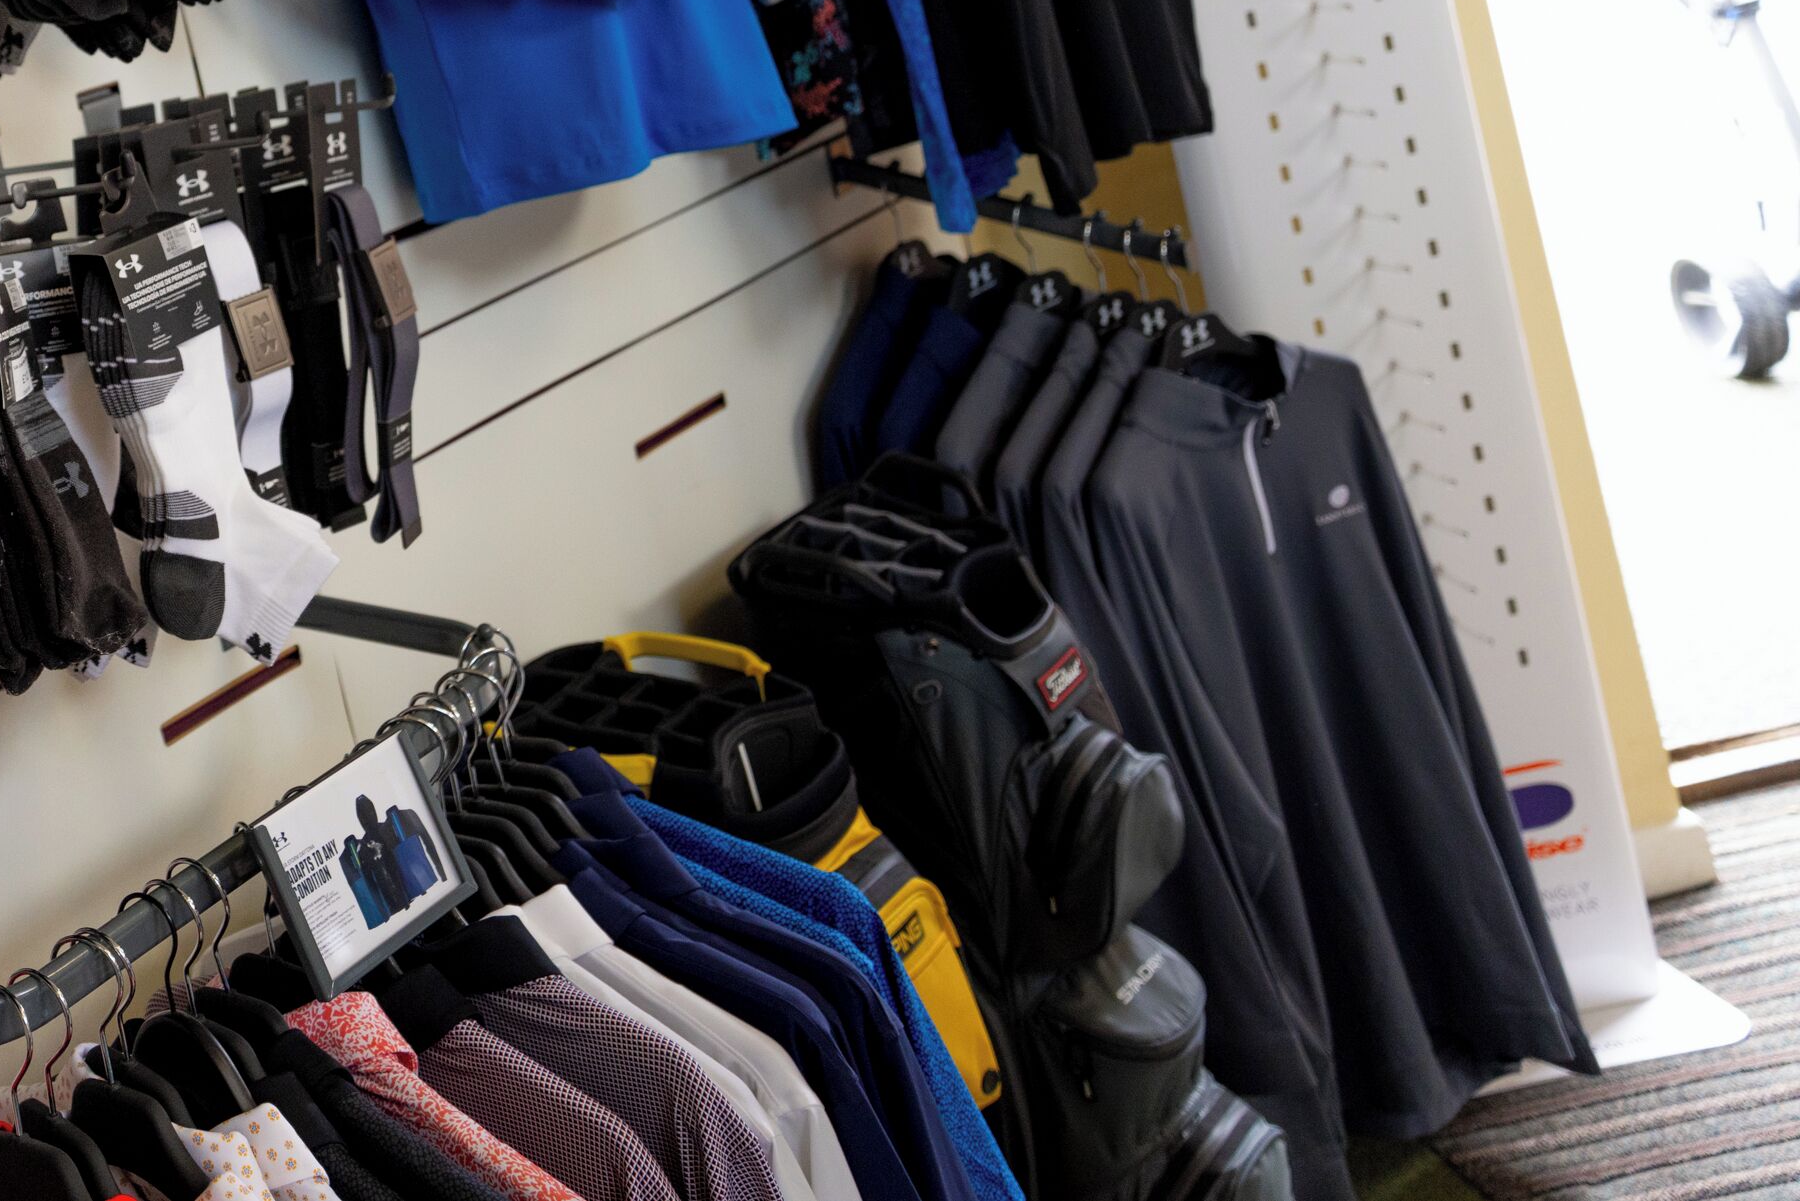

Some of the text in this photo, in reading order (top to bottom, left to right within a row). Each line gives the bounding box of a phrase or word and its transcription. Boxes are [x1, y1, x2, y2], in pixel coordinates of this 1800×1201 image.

[179, 259, 193, 270] TECH
[286, 838, 339, 885] ADAPTS TO ANY
[293, 864, 332, 902] CONDITION
